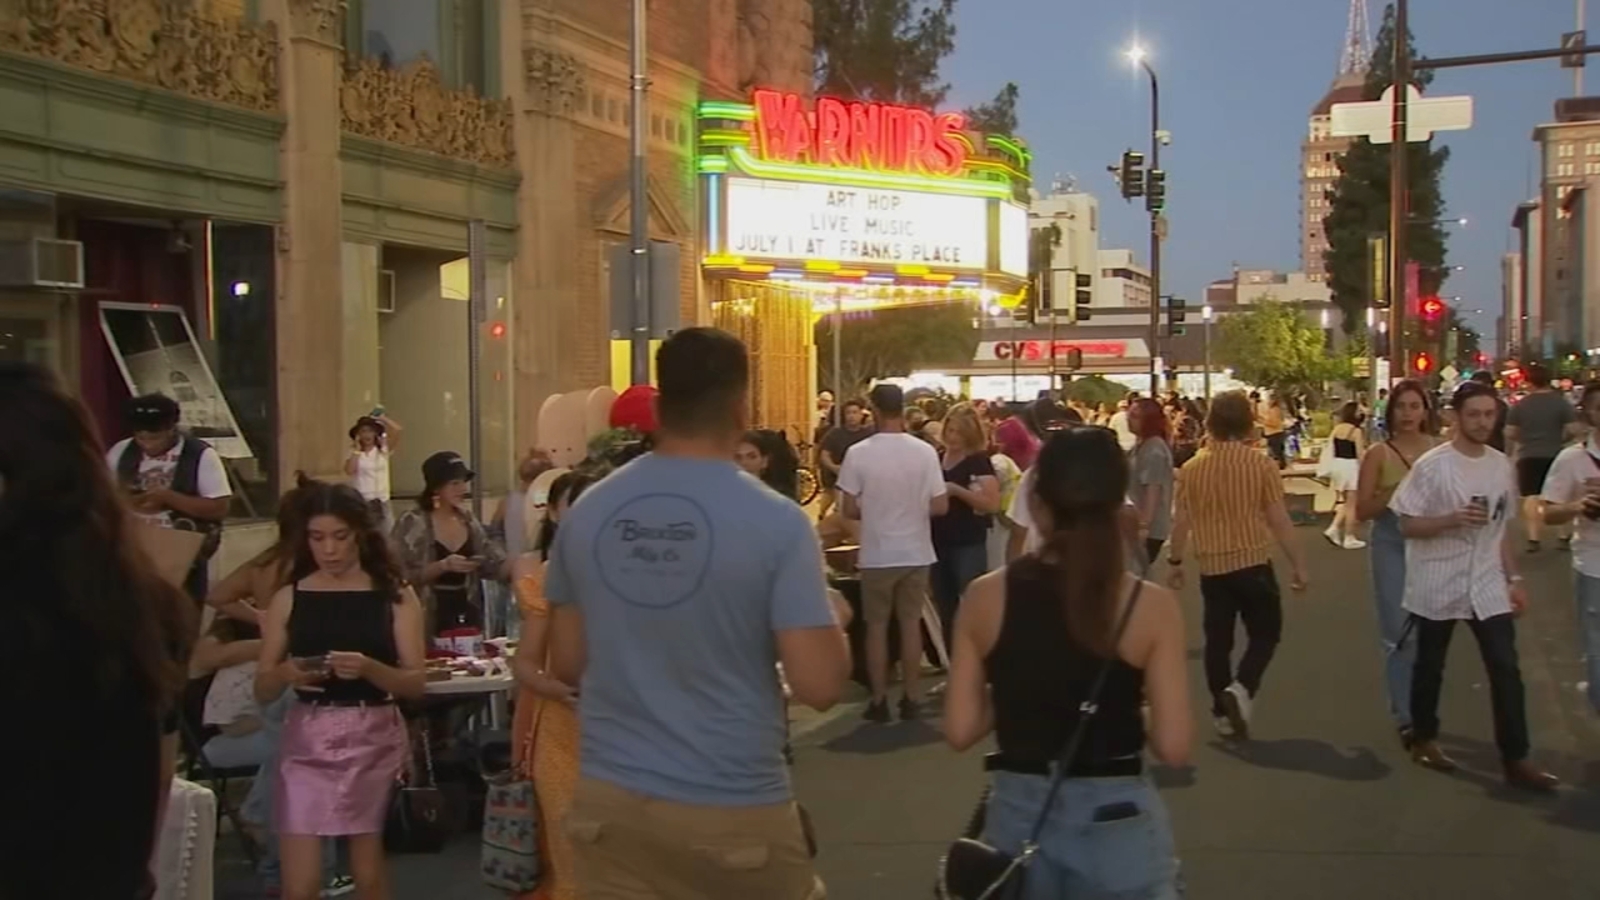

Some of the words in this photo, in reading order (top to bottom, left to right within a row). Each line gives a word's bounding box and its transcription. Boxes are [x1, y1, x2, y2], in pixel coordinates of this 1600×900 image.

[826, 190, 856, 208] ART
[868, 194, 901, 211] HOP
[811, 213, 849, 232] LIVE
[865, 218, 915, 236] MUSIC
[736, 235, 778, 252] JULY
[805, 238, 824, 254] AT
[840, 240, 902, 260] FRANKS
[912, 244, 961, 263] PLACE
[994, 341, 1041, 359] CVS
